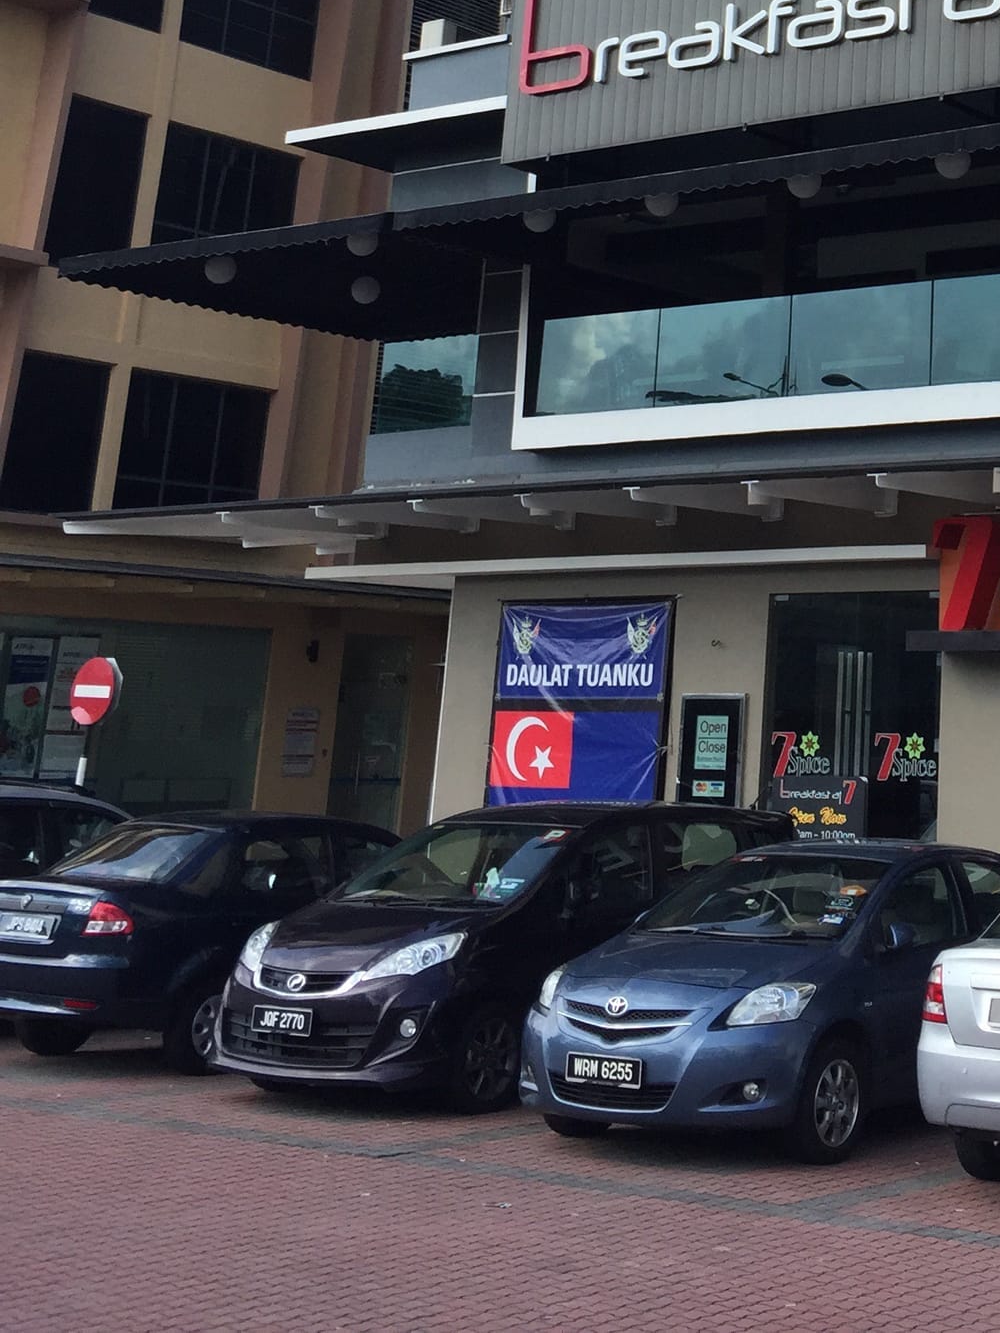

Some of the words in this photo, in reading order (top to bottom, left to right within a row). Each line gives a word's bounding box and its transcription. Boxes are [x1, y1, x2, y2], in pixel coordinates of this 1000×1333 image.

[506, 664, 573, 687] DAULAT
[577, 664, 654, 687] TUANKU
[700, 720, 727, 735] Open
[698, 740, 726, 754] Close
[771, 731, 797, 778] 7
[787, 746, 831, 777] Spice
[874, 732, 901, 782] 7
[891, 748, 937, 782] Spice
[780, 779, 830, 799] breakfast
[843, 779, 857, 805] 7
[280, 1012, 305, 1030] 2770
[574, 1057, 599, 1078] WRM
[601, 1061, 633, 1081] 6255
